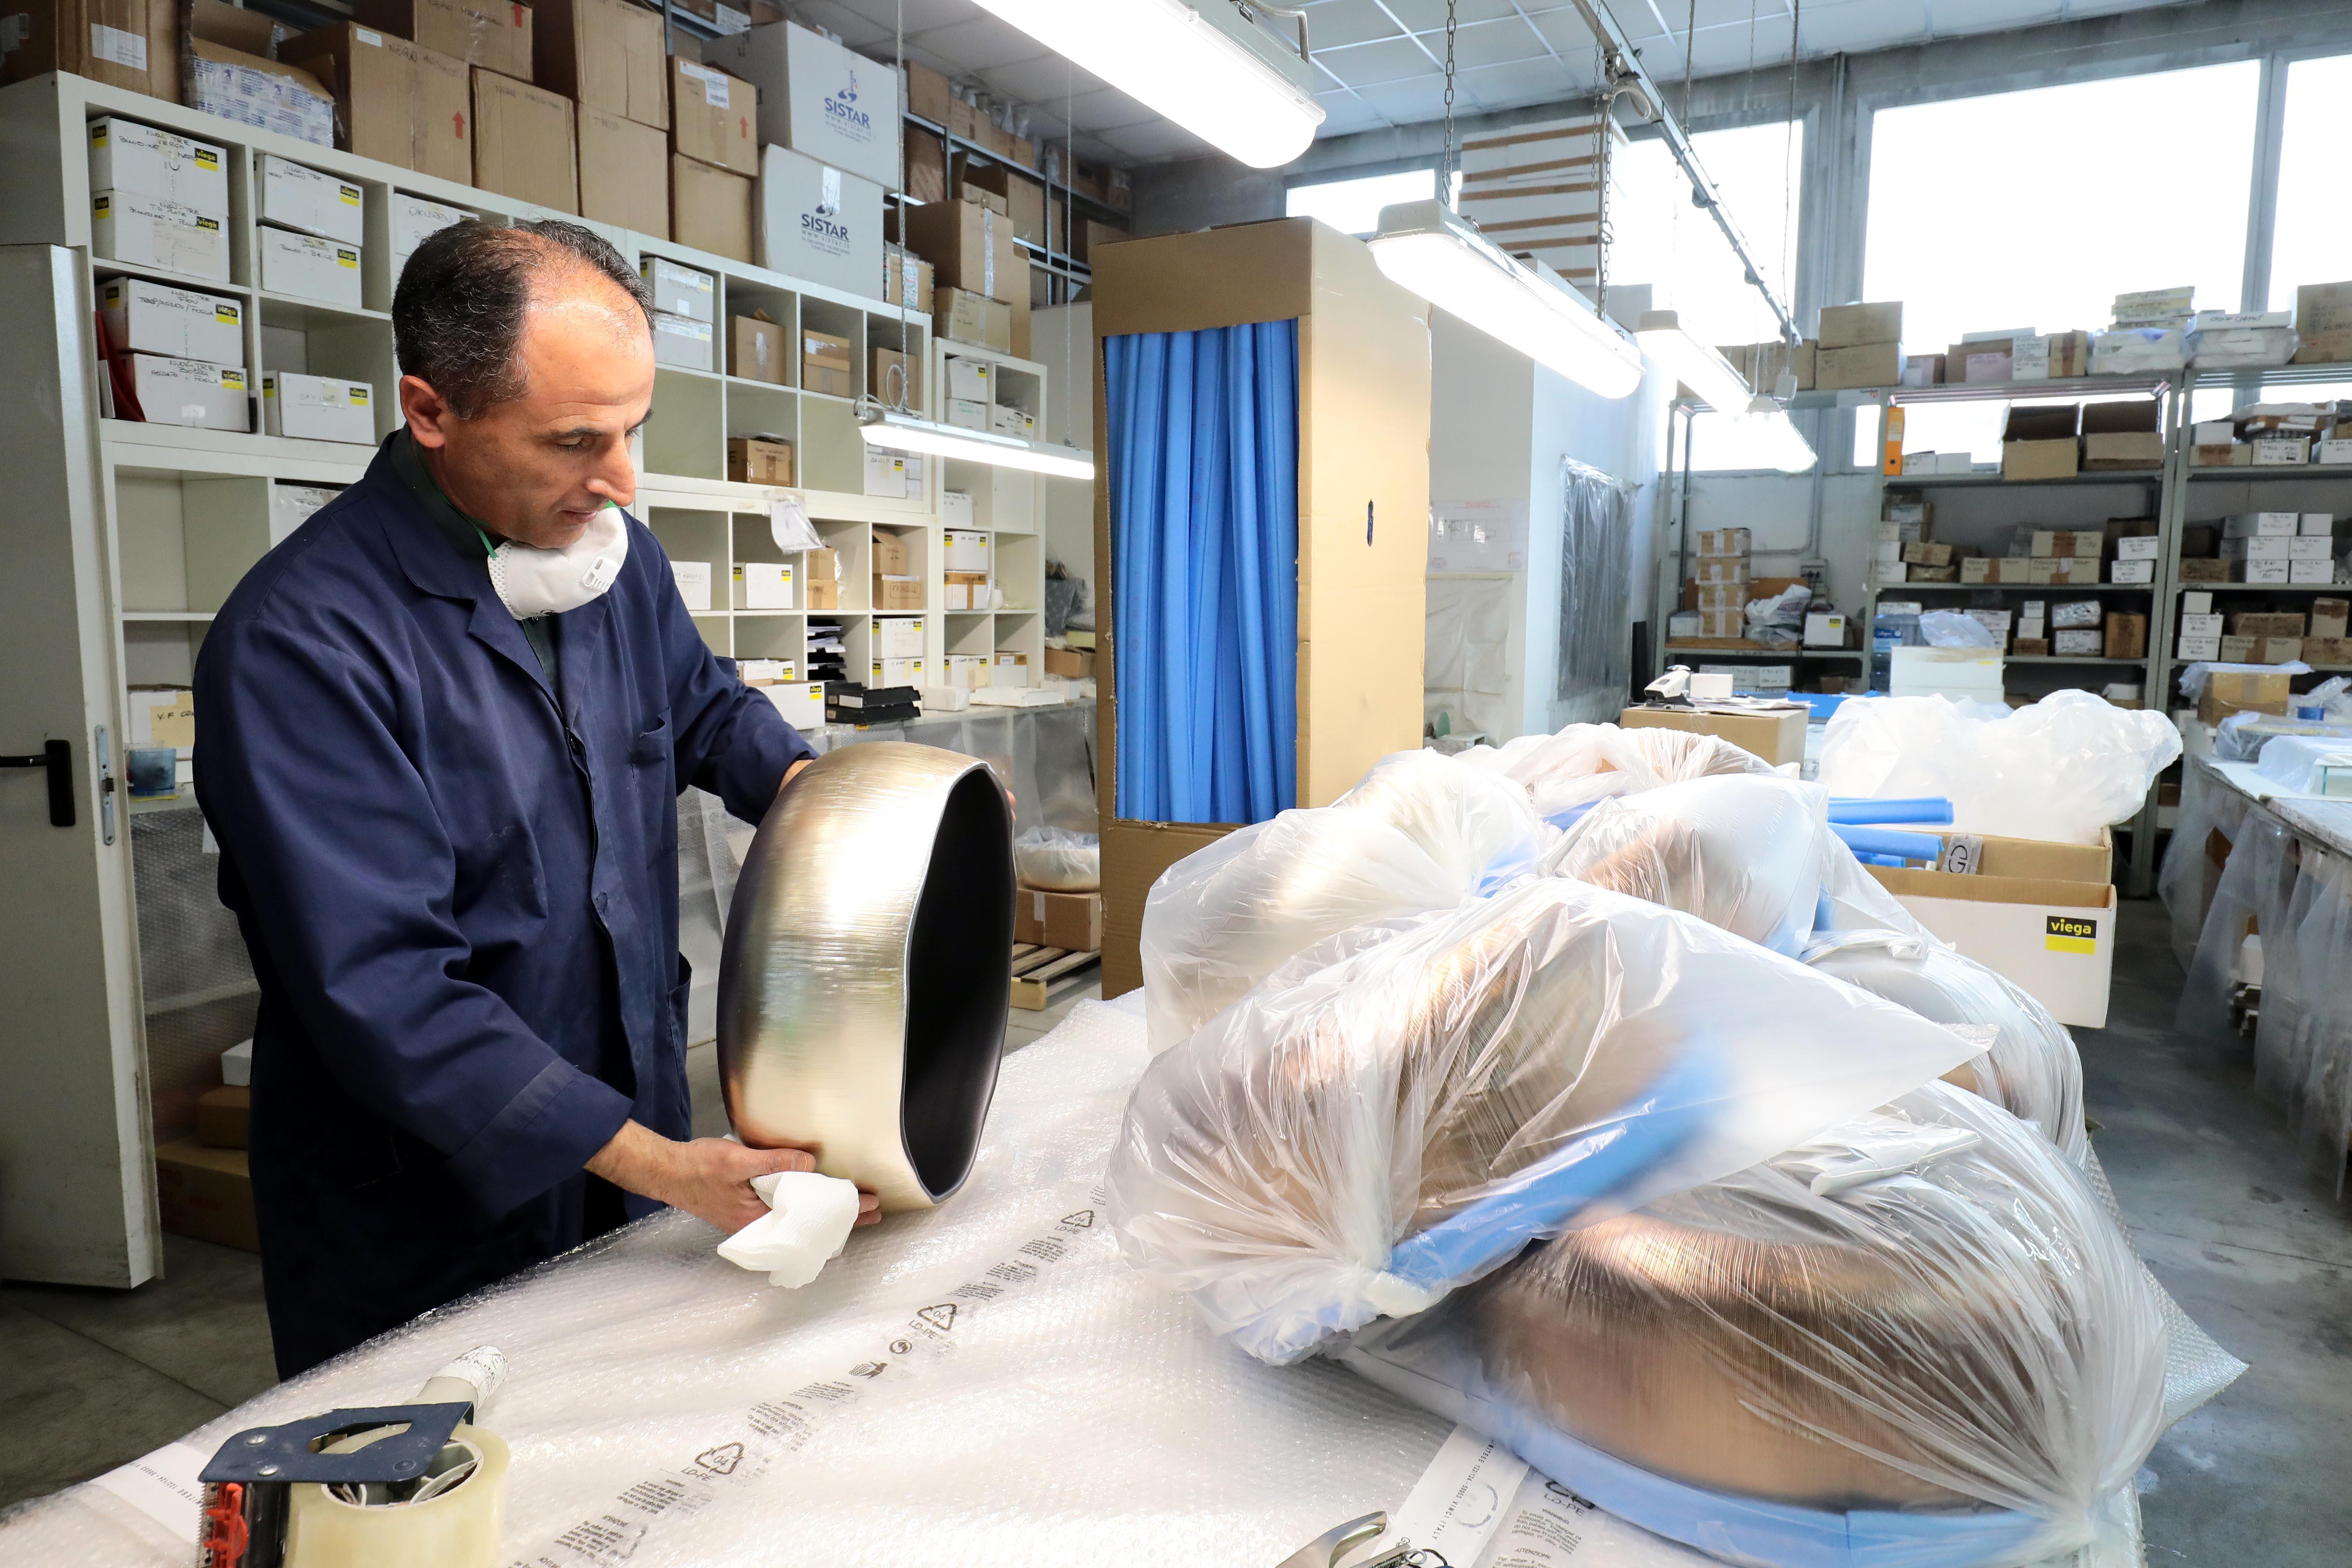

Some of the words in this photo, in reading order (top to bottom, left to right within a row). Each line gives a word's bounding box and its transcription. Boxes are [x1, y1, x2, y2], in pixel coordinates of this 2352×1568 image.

[825, 97, 870, 128] SISTAR
[196, 150, 215, 161] viega
[341, 187, 359, 198] viega
[198, 218, 217, 230] viega
[801, 213, 849, 240] SISTAR
[2051, 919, 2092, 936] viega
[1054, 1225, 1081, 1234] LD-PE
[908, 1319, 939, 1340] LD-PE
[713, 1455, 728, 1467] 04
[680, 1467, 715, 1482] LD-PE
[1467, 1465, 1481, 1482] 122/124
[1456, 1485, 1468, 1499] 50053
[1443, 1501, 1459, 1519] VINCI
[1543, 1493, 1585, 1517] LD-PE
[1542, 1508, 1570, 1524] WARNING
[1431, 1521, 1446, 1540] ITALY
[1556, 1523, 1575, 1536] danger
[1514, 1548, 1551, 1560] ATTENZIONE
